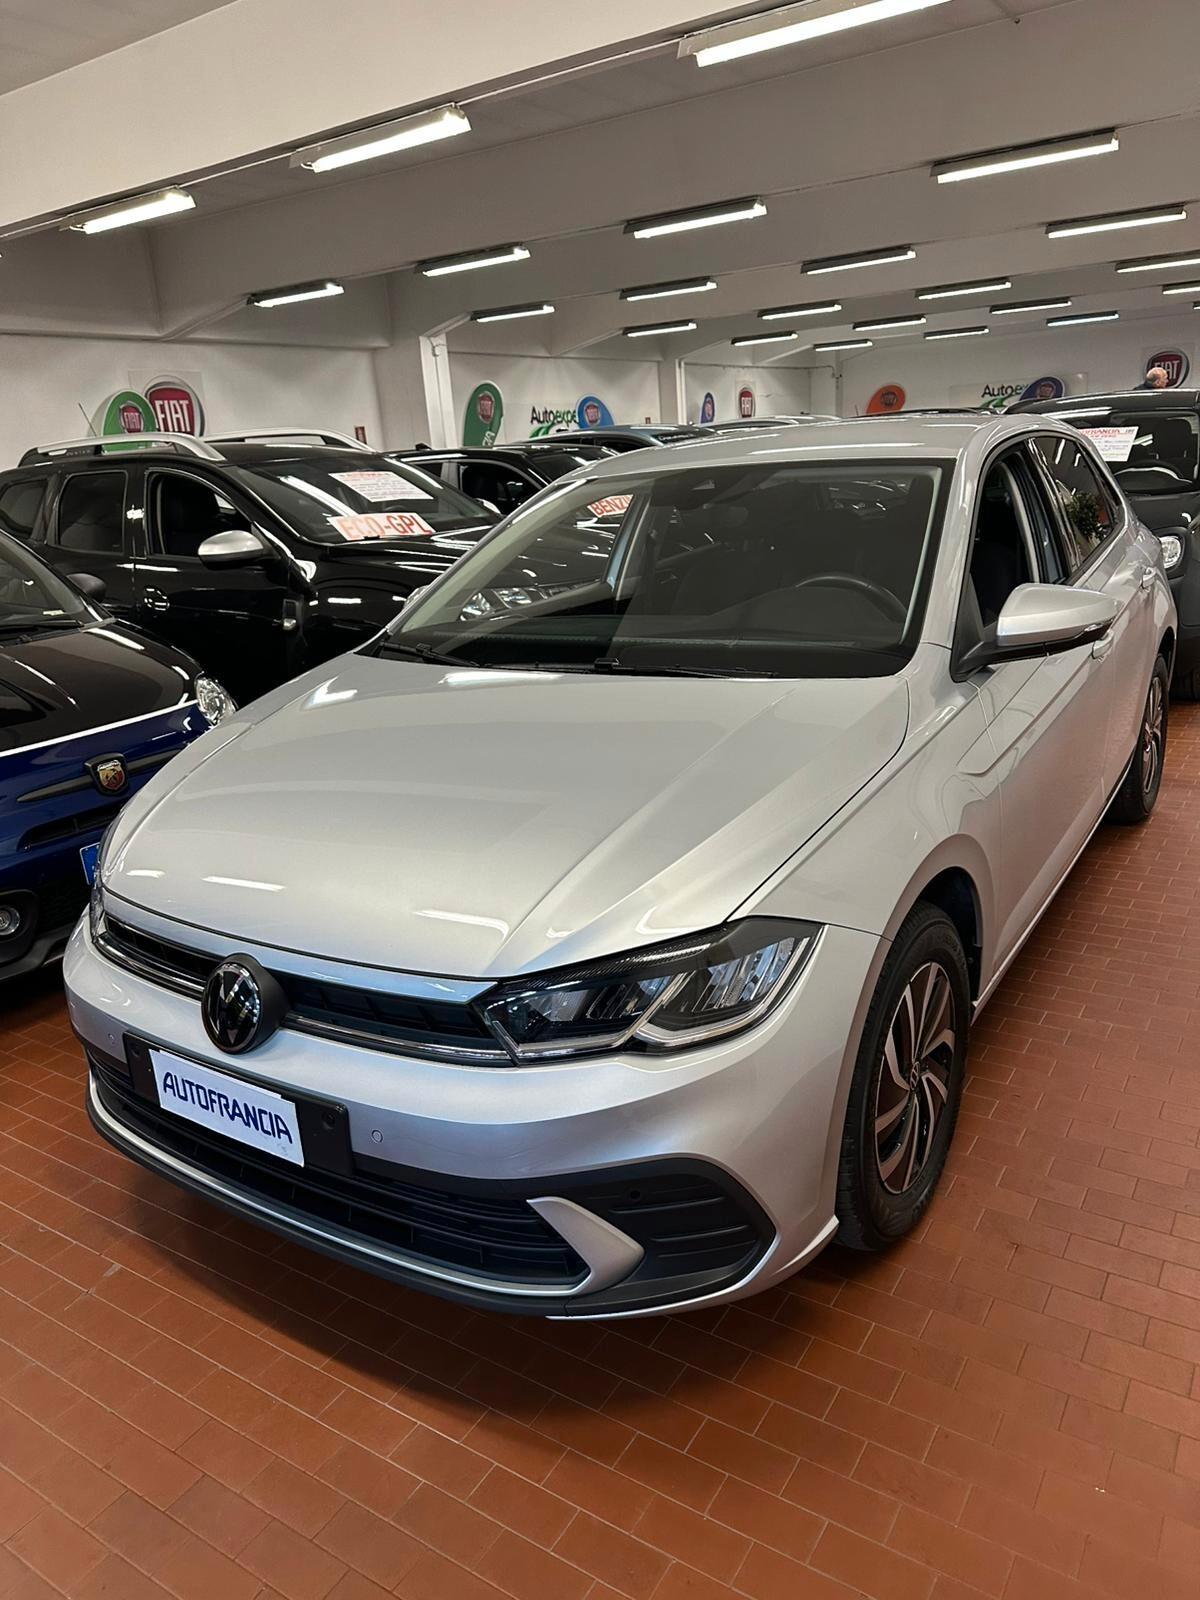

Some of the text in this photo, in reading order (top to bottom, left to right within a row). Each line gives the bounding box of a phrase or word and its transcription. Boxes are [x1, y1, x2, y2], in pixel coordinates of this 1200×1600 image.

[1154, 360, 1180, 380] AT
[154, 400, 190, 432] FIAT
[336, 514, 433, 539] ECO-GPL
[163, 1071, 293, 1144] AUTOFRANCIA
